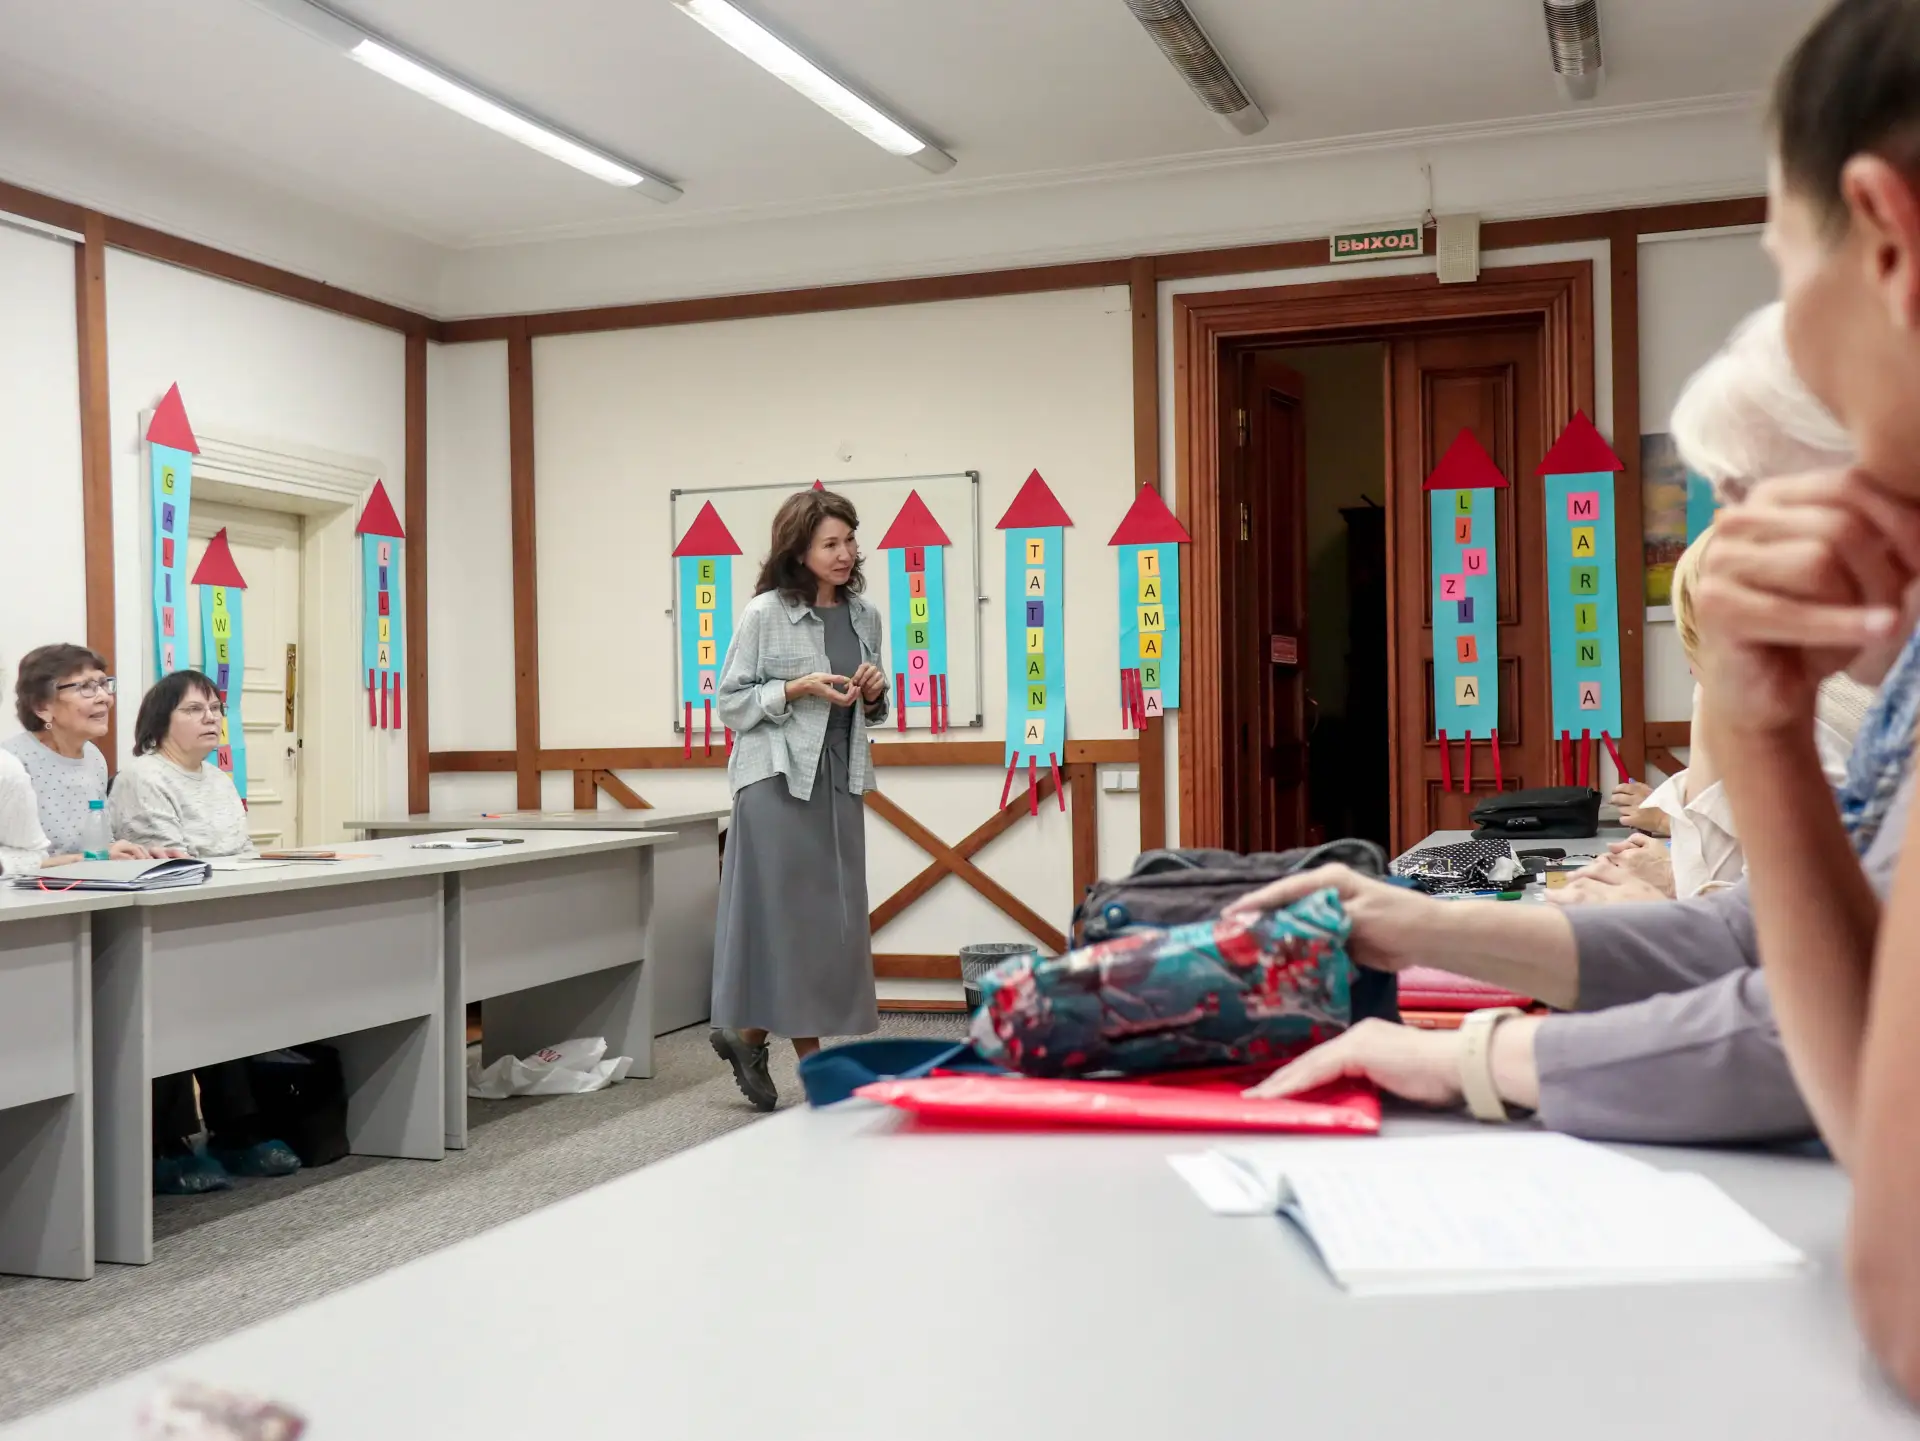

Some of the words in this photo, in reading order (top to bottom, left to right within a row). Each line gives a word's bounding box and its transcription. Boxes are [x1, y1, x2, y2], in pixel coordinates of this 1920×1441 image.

[1337, 233, 1415, 252] ВЫХОД
[164, 473, 174, 666] GALINA
[379, 547, 389, 664] LILJA
[702, 565, 713, 690] EDITA
[913, 553, 925, 695] LJUBOV
[1027, 544, 1043, 739] TATJANA
[1144, 556, 1159, 710] TAMARA
[1446, 495, 1480, 698] LJUZIJA
[1574, 500, 1596, 705] MARINA
